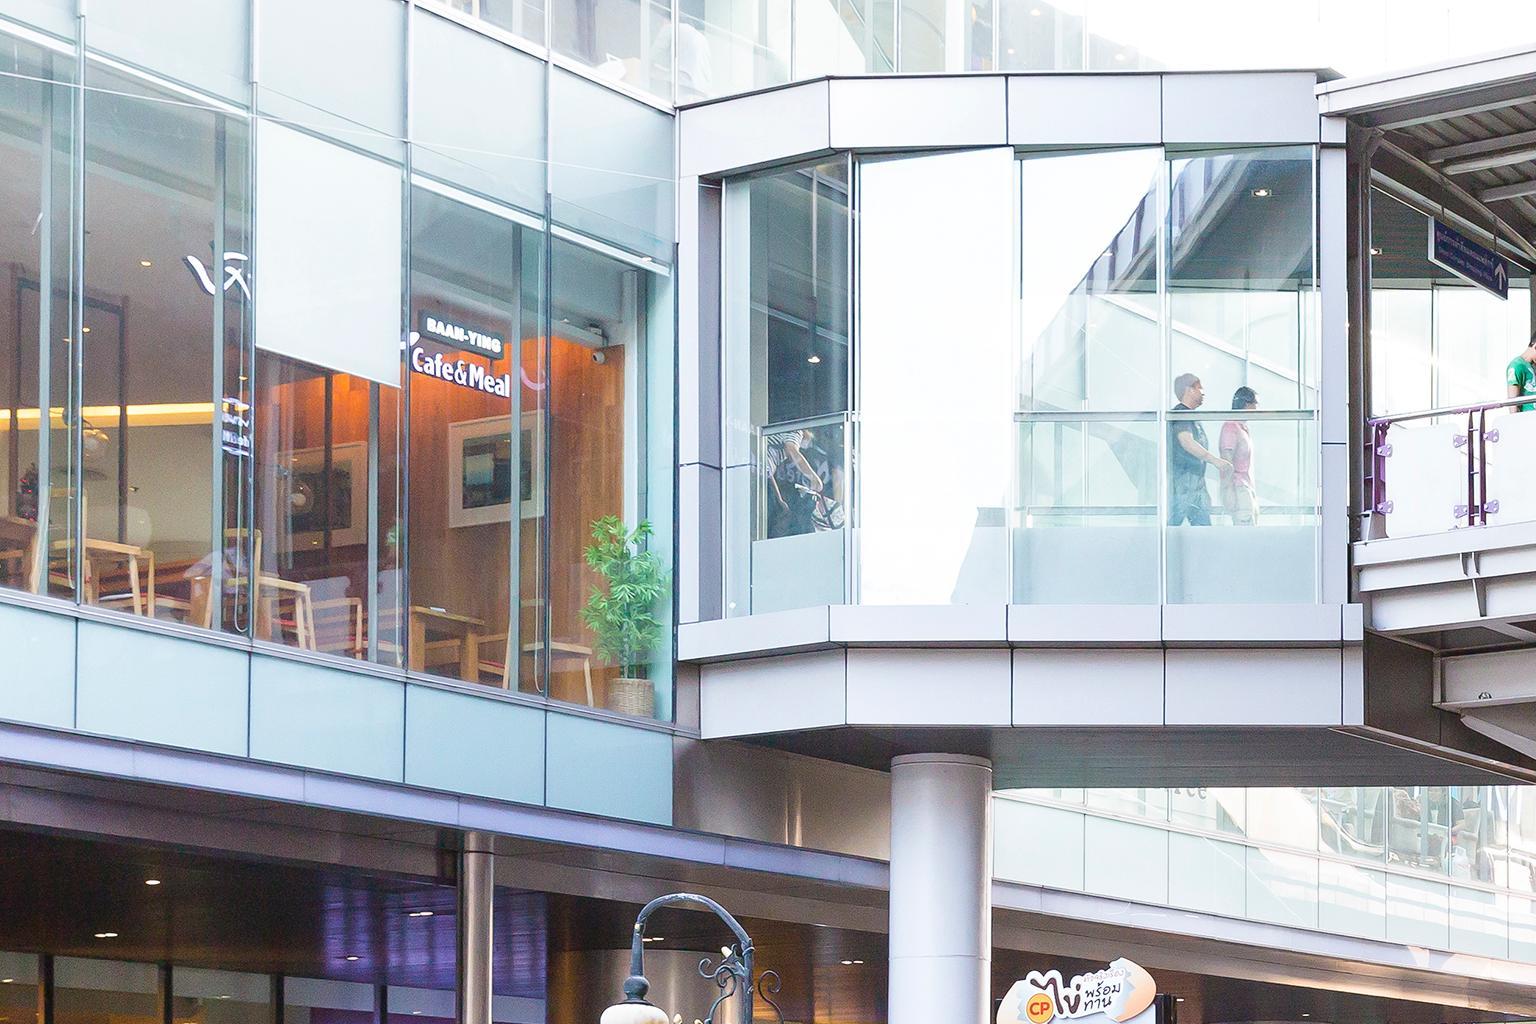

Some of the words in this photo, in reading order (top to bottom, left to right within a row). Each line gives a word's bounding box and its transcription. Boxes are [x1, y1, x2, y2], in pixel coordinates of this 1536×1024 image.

[426, 316, 502, 354] BAAN-YING
[412, 346, 510, 398] Cafe&Meal
[1084, 980, 1122, 999] พร้อม
[1029, 1001, 1050, 1016] CP
[1083, 995, 1113, 1012] ทาน
